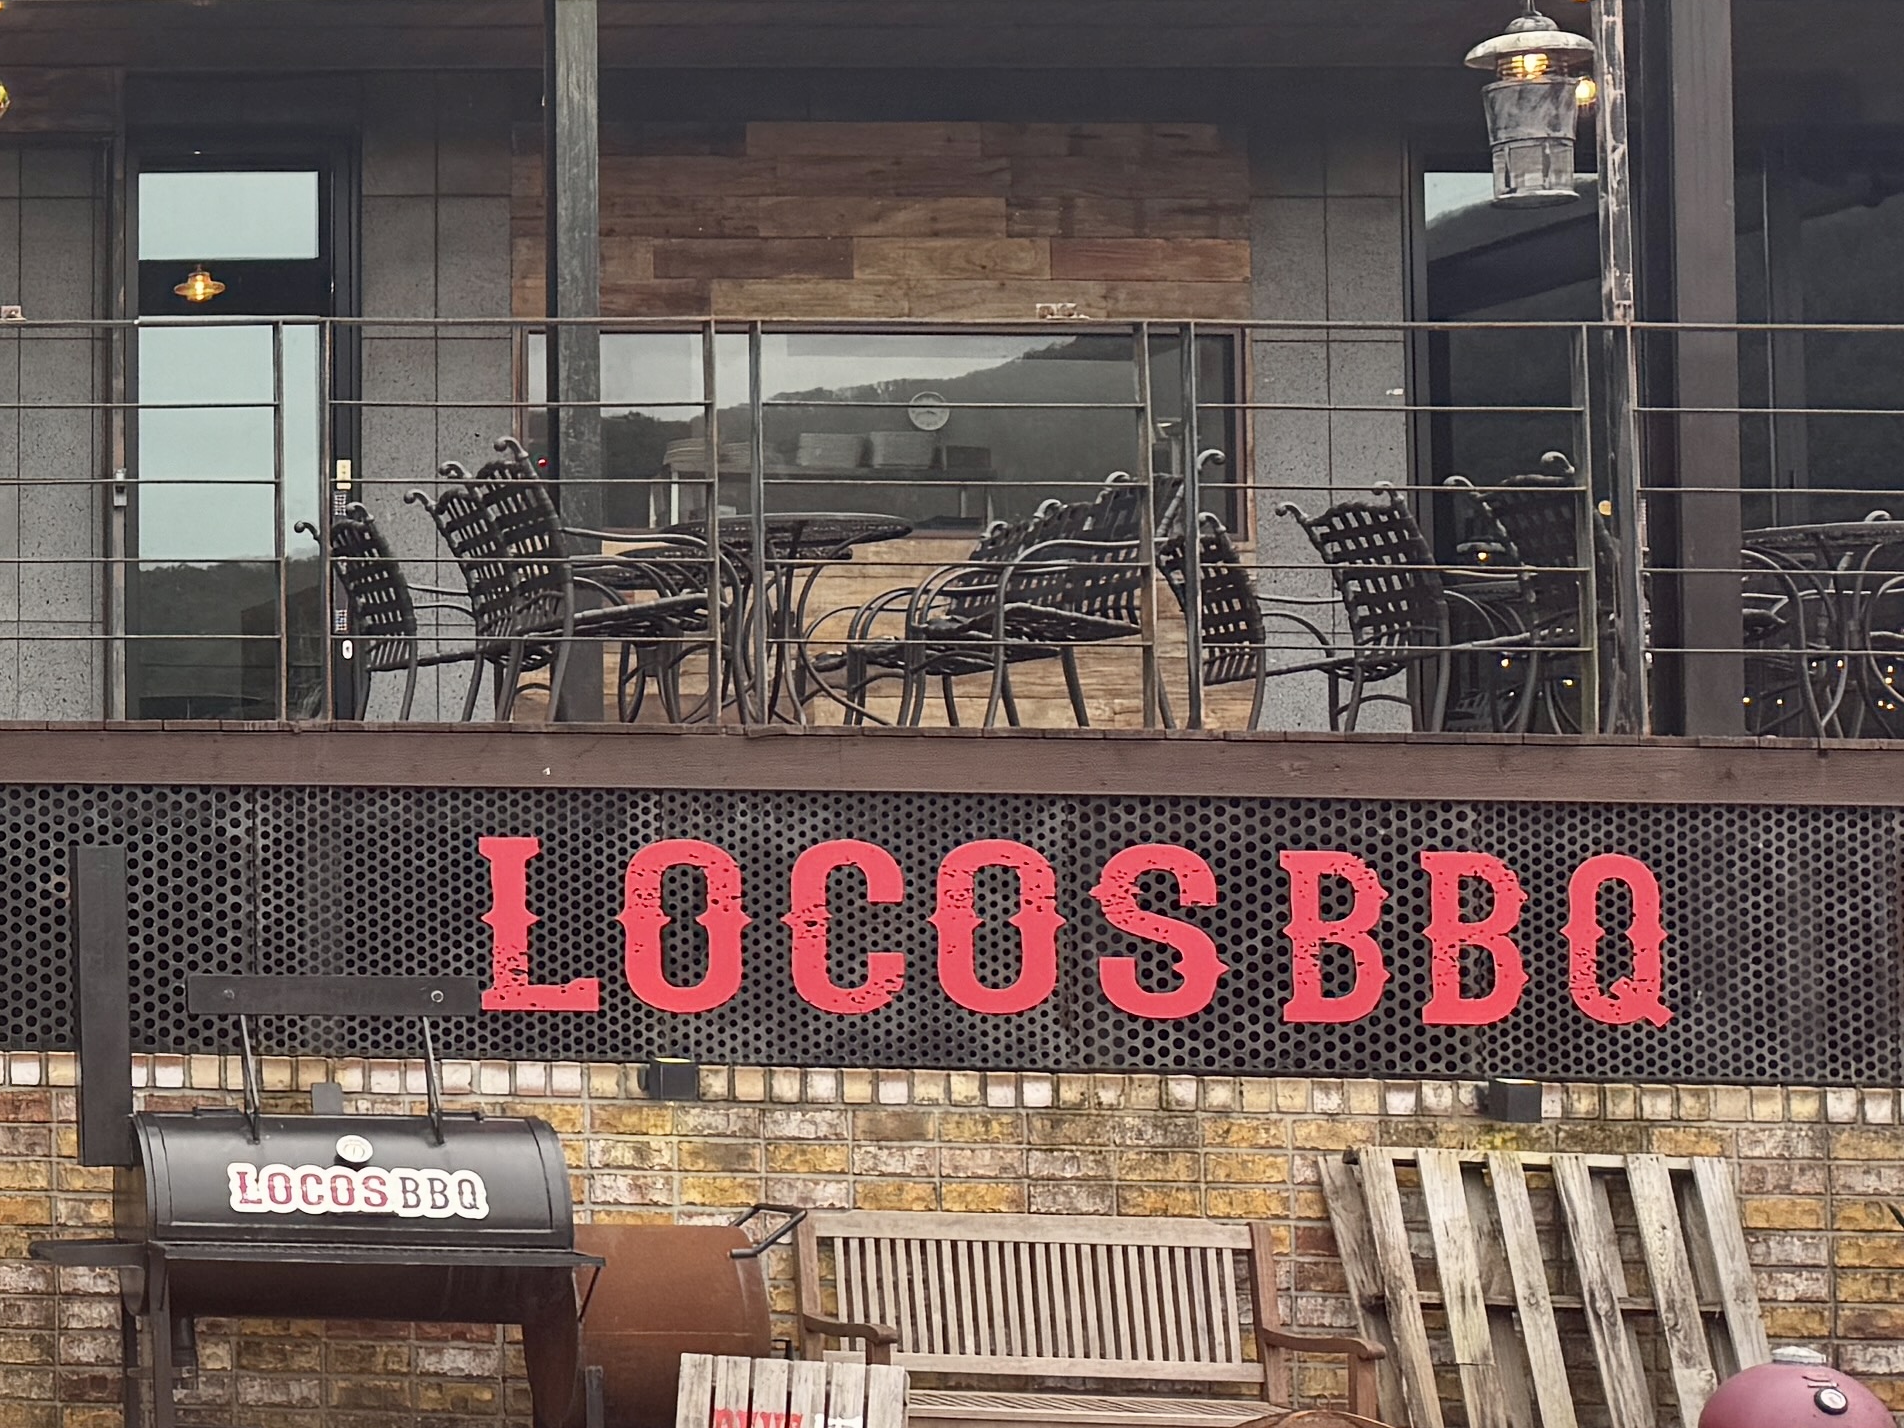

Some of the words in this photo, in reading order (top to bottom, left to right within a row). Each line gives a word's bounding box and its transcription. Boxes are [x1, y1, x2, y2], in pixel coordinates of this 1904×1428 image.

[478, 836, 1230, 1020] LOCOS
[1278, 850, 1674, 1028] BBQ
[236, 1171, 388, 1207] LOCOS
[399, 1176, 480, 1210] BBQ
